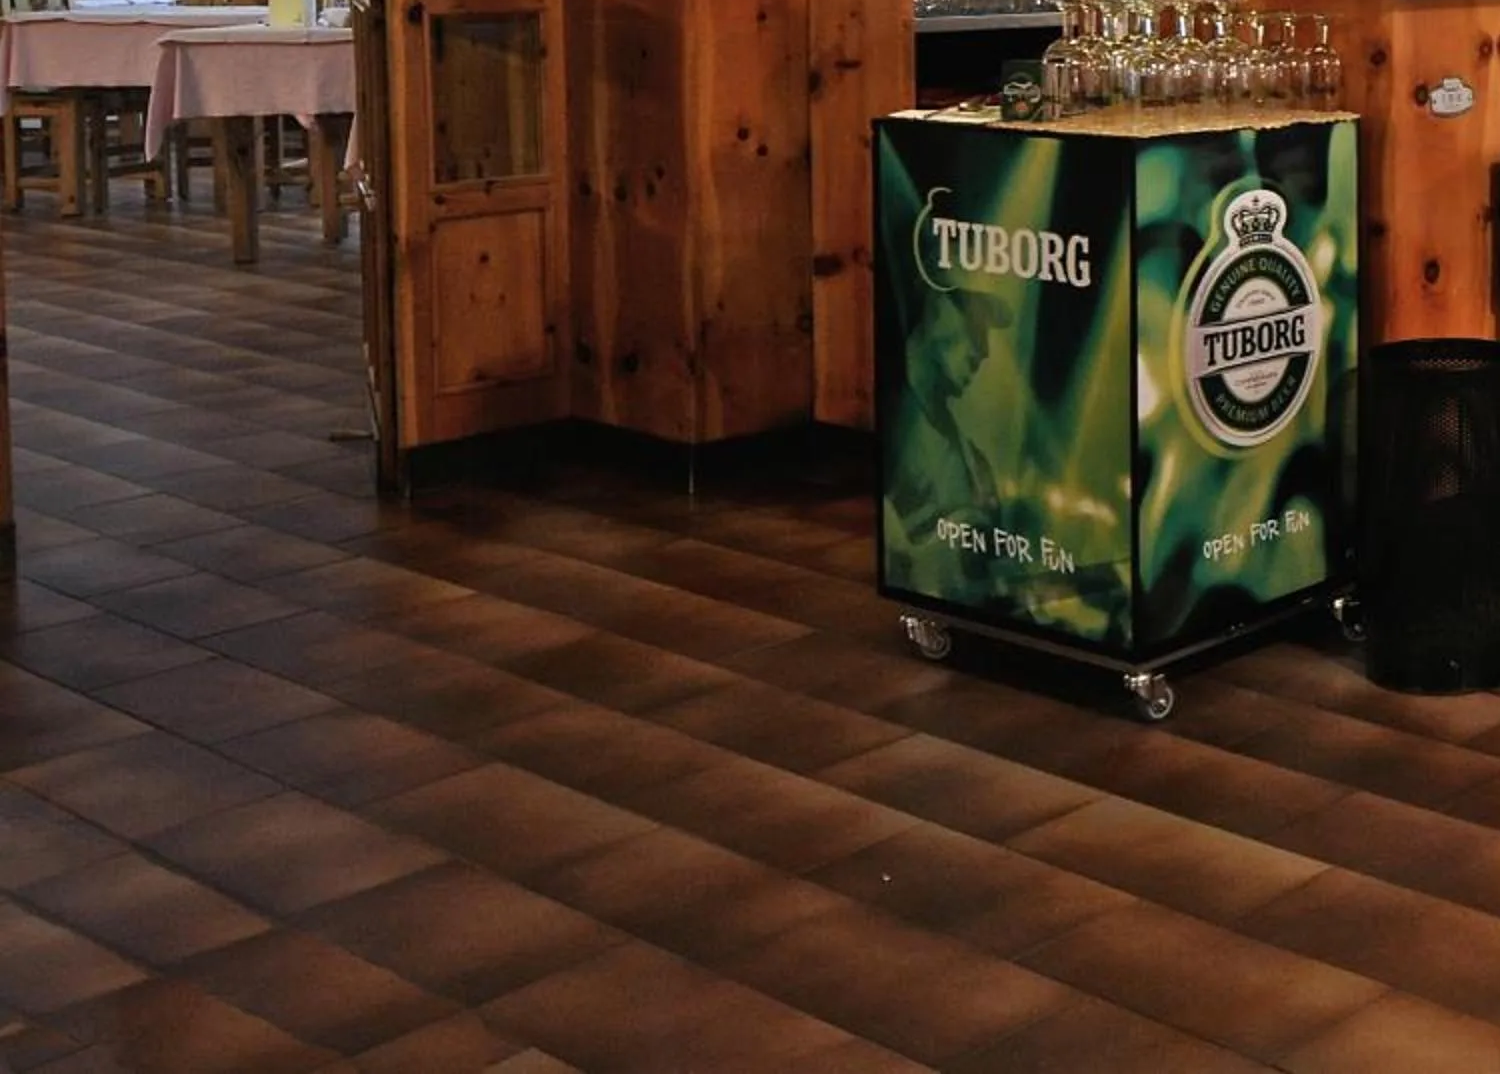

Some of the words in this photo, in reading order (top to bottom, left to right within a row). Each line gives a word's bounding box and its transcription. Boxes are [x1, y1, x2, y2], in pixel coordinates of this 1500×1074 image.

[932, 217, 1091, 288] TUBORG
[1203, 314, 1305, 366] TUBORG
[936, 517, 986, 553] OPEN
[993, 527, 1033, 563] FOR
[1039, 536, 1075, 574] FUN
[1203, 533, 1245, 562] OPEN
[1250, 519, 1280, 547] FOR
